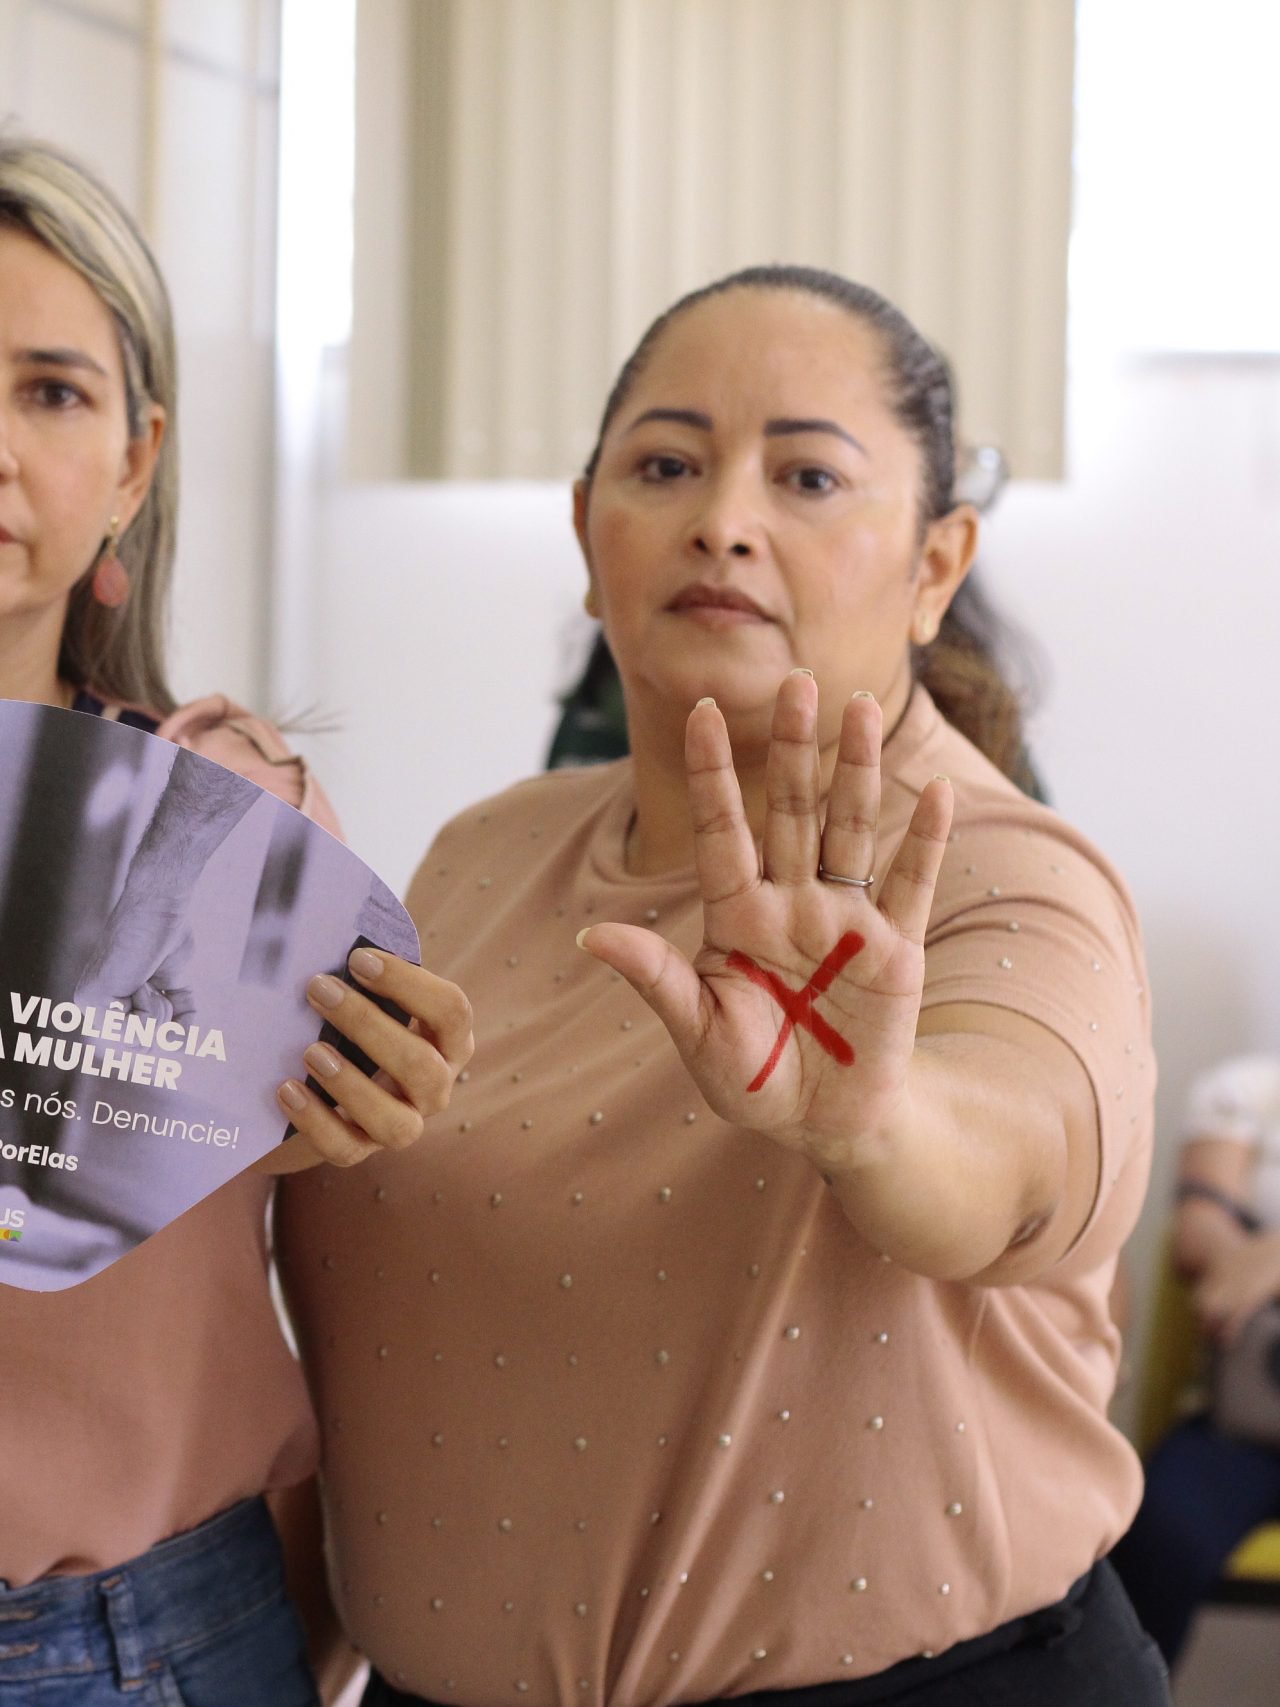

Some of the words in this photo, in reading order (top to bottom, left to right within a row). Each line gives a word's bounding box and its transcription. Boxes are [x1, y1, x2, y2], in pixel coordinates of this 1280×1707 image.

[10, 991, 227, 1062] VIOLÊNCIA
[13, 1031, 183, 1091] MULHER
[23, 1090, 82, 1122] nós.
[91, 1100, 240, 1150] Denuncie!
